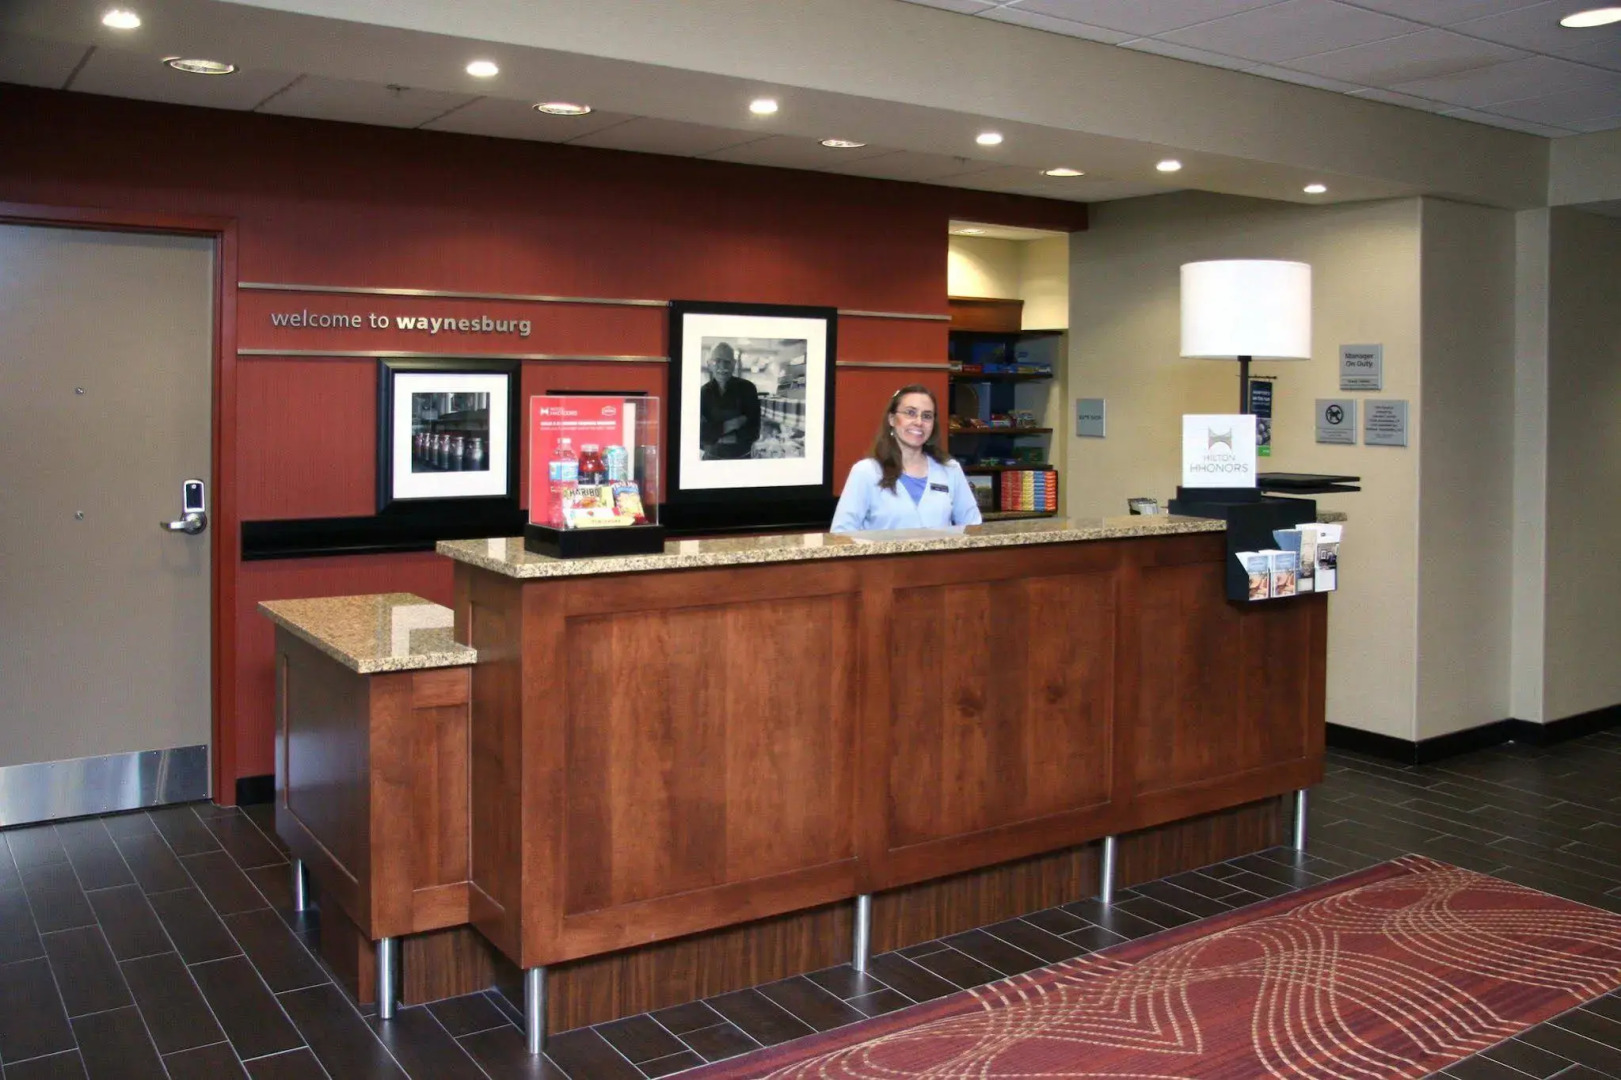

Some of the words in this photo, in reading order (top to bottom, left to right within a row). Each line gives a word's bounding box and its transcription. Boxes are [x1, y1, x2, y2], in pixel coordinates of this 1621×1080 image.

[271, 309, 362, 328] welcome
[369, 312, 390, 329] to
[396, 315, 532, 337] waynesburg
[1356, 360, 1373, 368] Duty
[1203, 454, 1236, 462] HILTON
[1189, 463, 1249, 473] HHONORS
[569, 487, 601, 497] HARIBO
